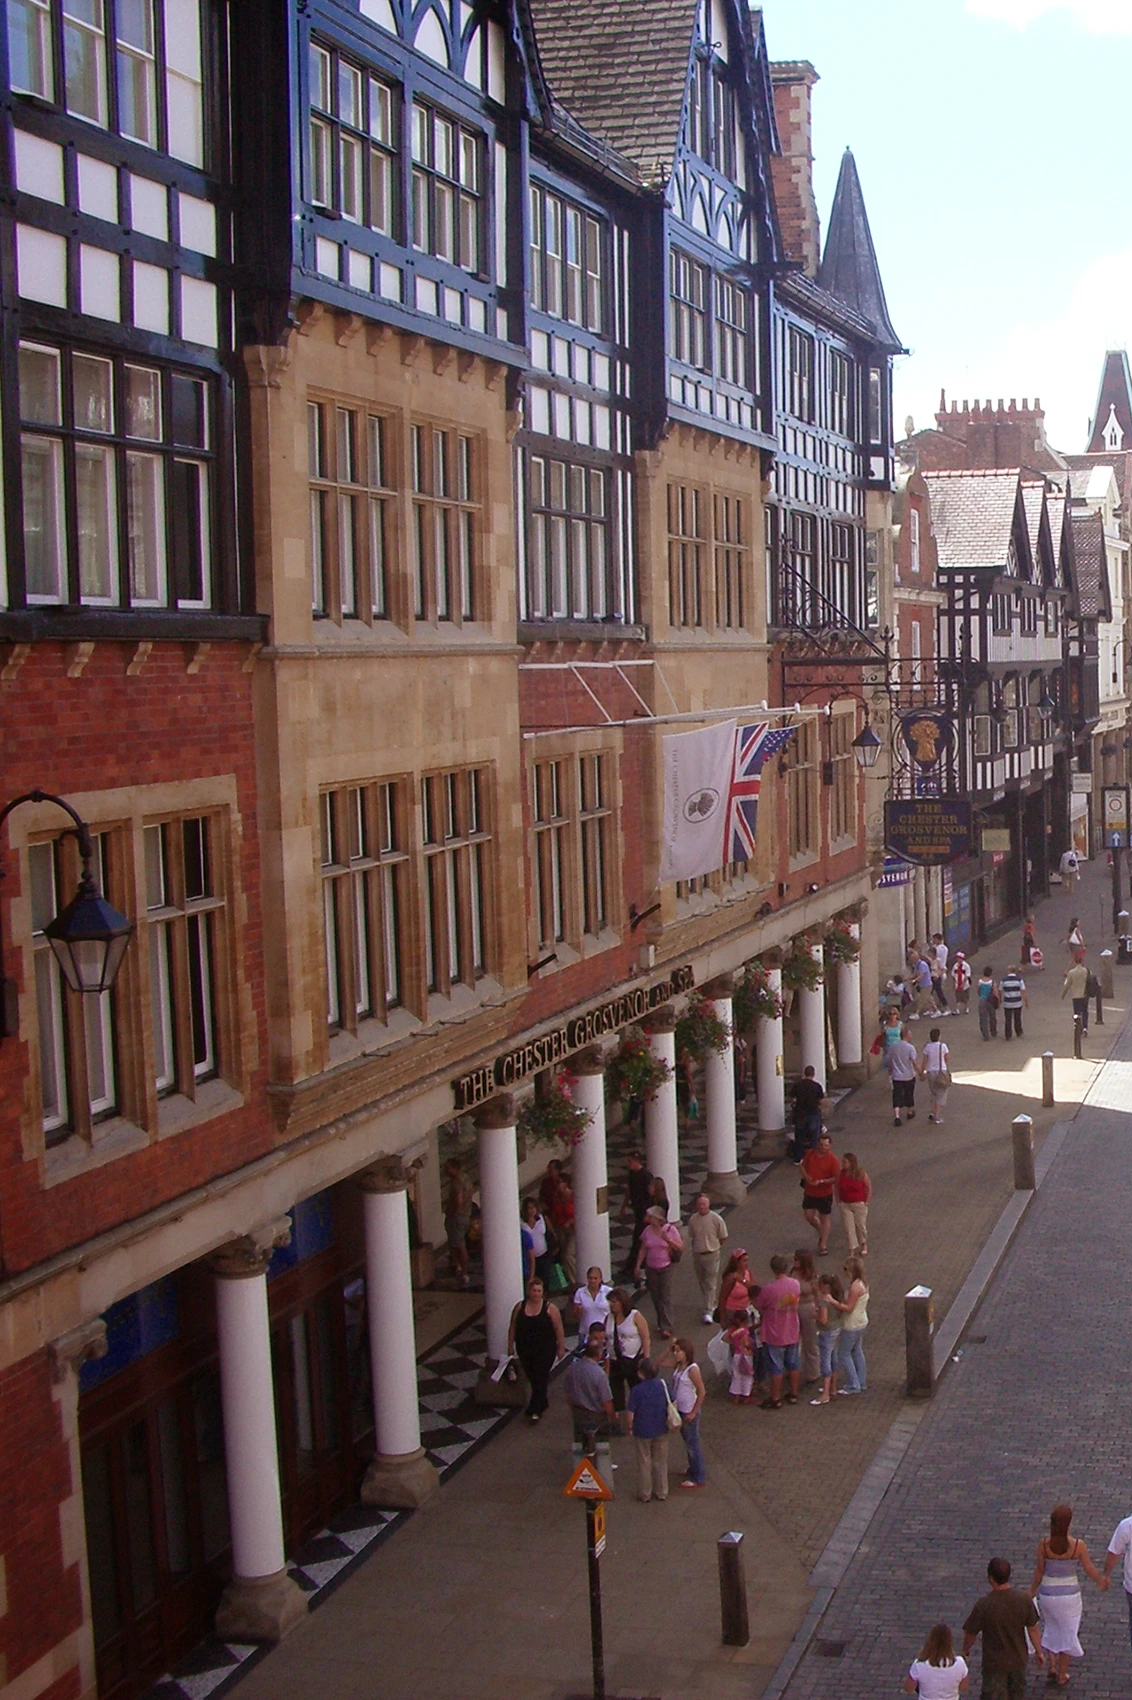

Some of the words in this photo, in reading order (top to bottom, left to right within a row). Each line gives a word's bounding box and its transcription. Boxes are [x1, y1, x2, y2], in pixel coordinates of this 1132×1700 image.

[916, 804, 942, 813] THE
[899, 815, 958, 824] CHESTER
[890, 825, 968, 835] GROSVENOR
[907, 836, 930, 844] AND
[932, 836, 952, 844] SPA
[460, 1067, 494, 1108] THE
[503, 1028, 568, 1086] CHESTER
[574, 989, 650, 1046] GROSVENOR
[654, 983, 674, 1002] AND
[677, 966, 696, 993] SPA
